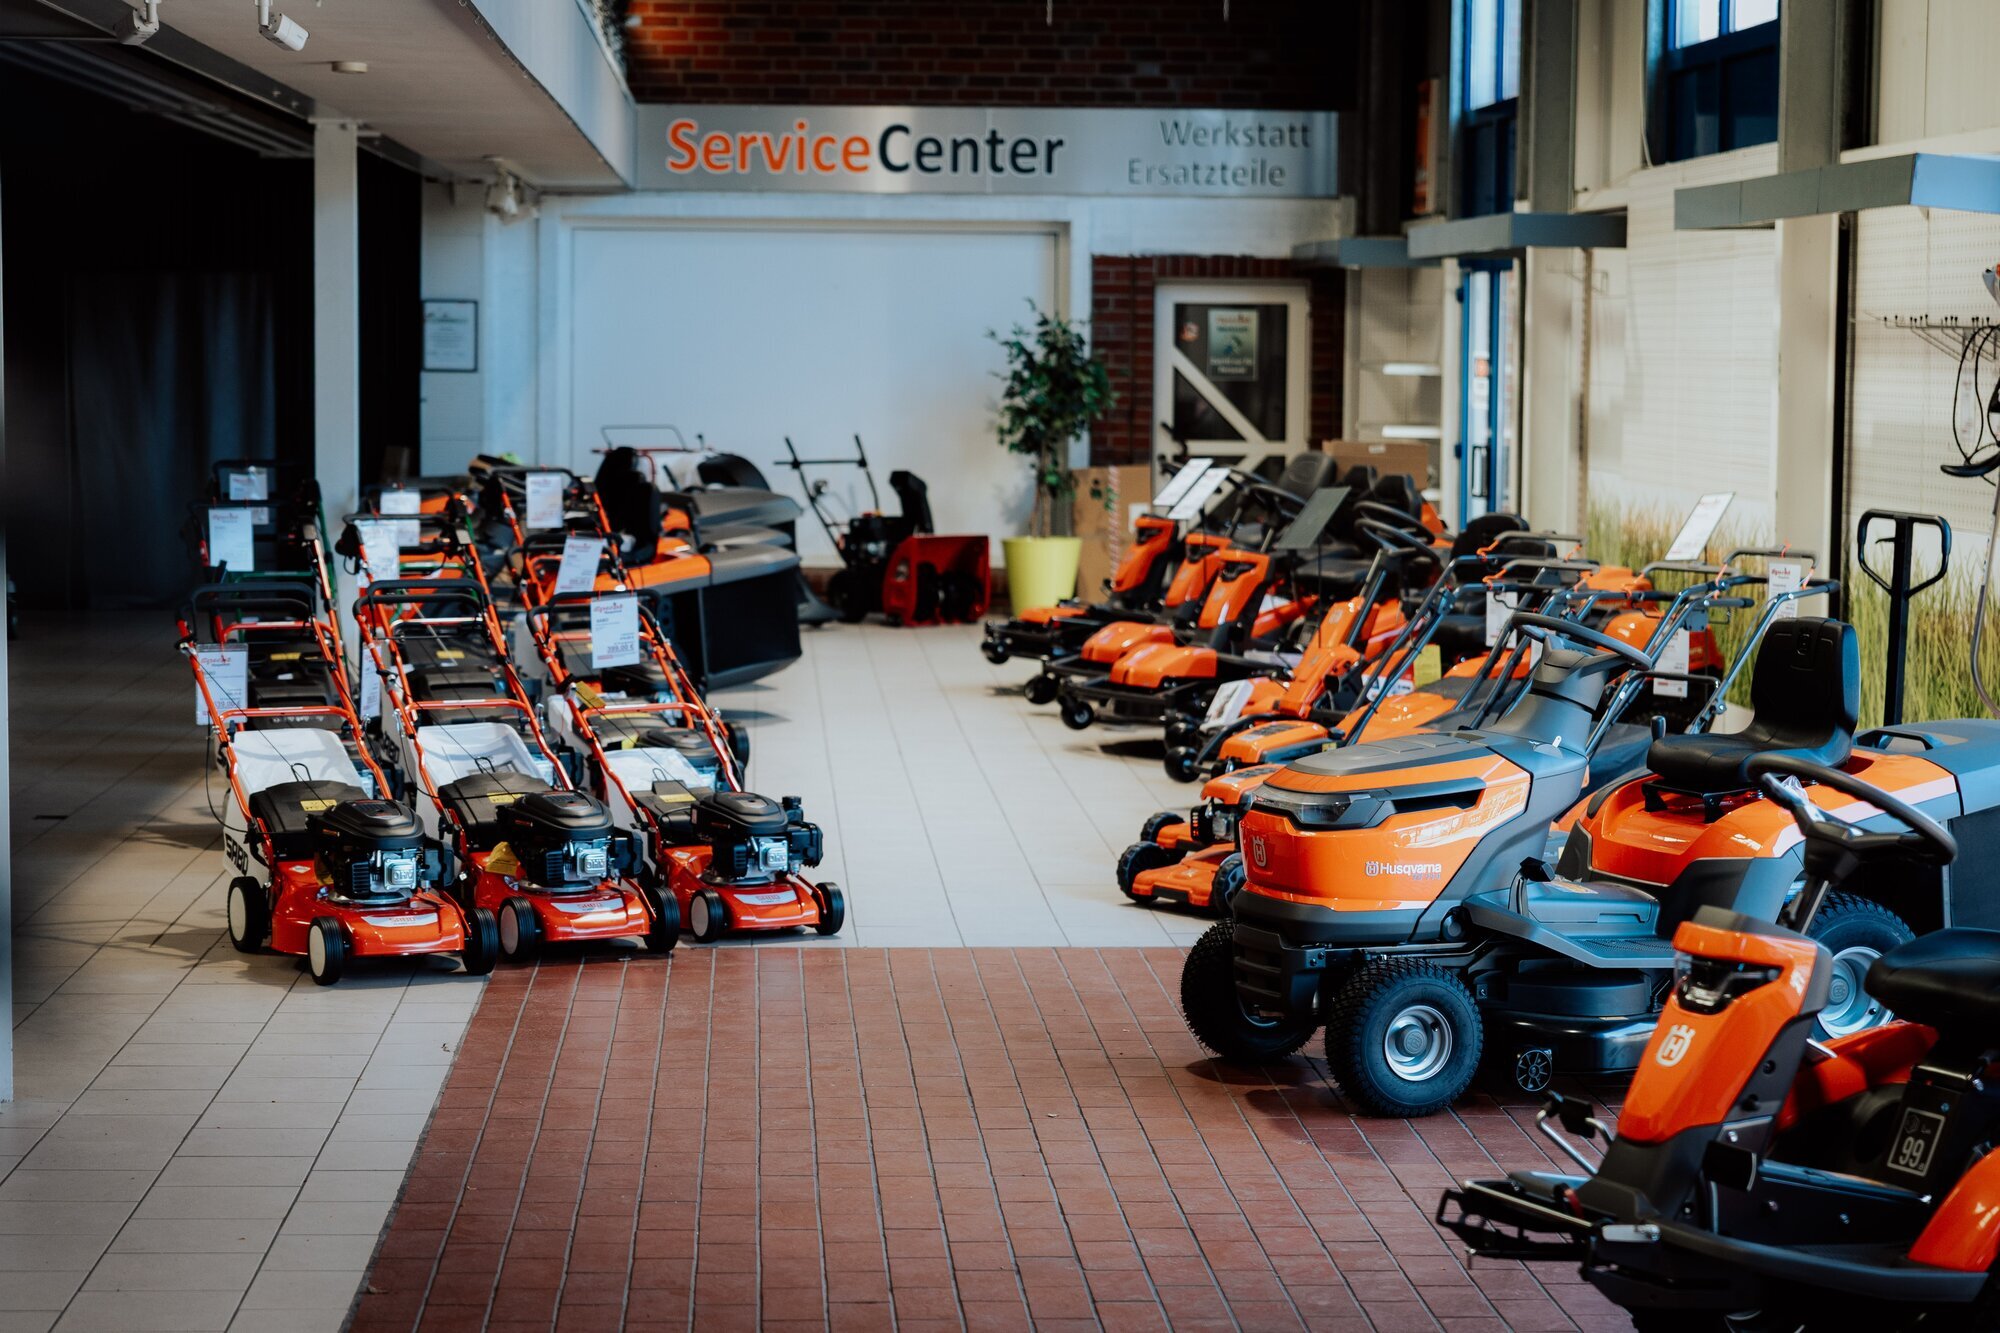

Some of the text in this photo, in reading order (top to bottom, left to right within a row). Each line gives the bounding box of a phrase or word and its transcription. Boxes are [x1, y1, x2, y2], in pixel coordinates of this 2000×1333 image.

[1159, 119, 1312, 148] Werkstatt
[1127, 157, 1286, 187] Ersatzteile
[225, 833, 248, 876] SABO
[393, 869, 414, 881] OHV
[1380, 862, 1442, 877] Husqvarna
[1898, 1136, 1925, 1168] 99
